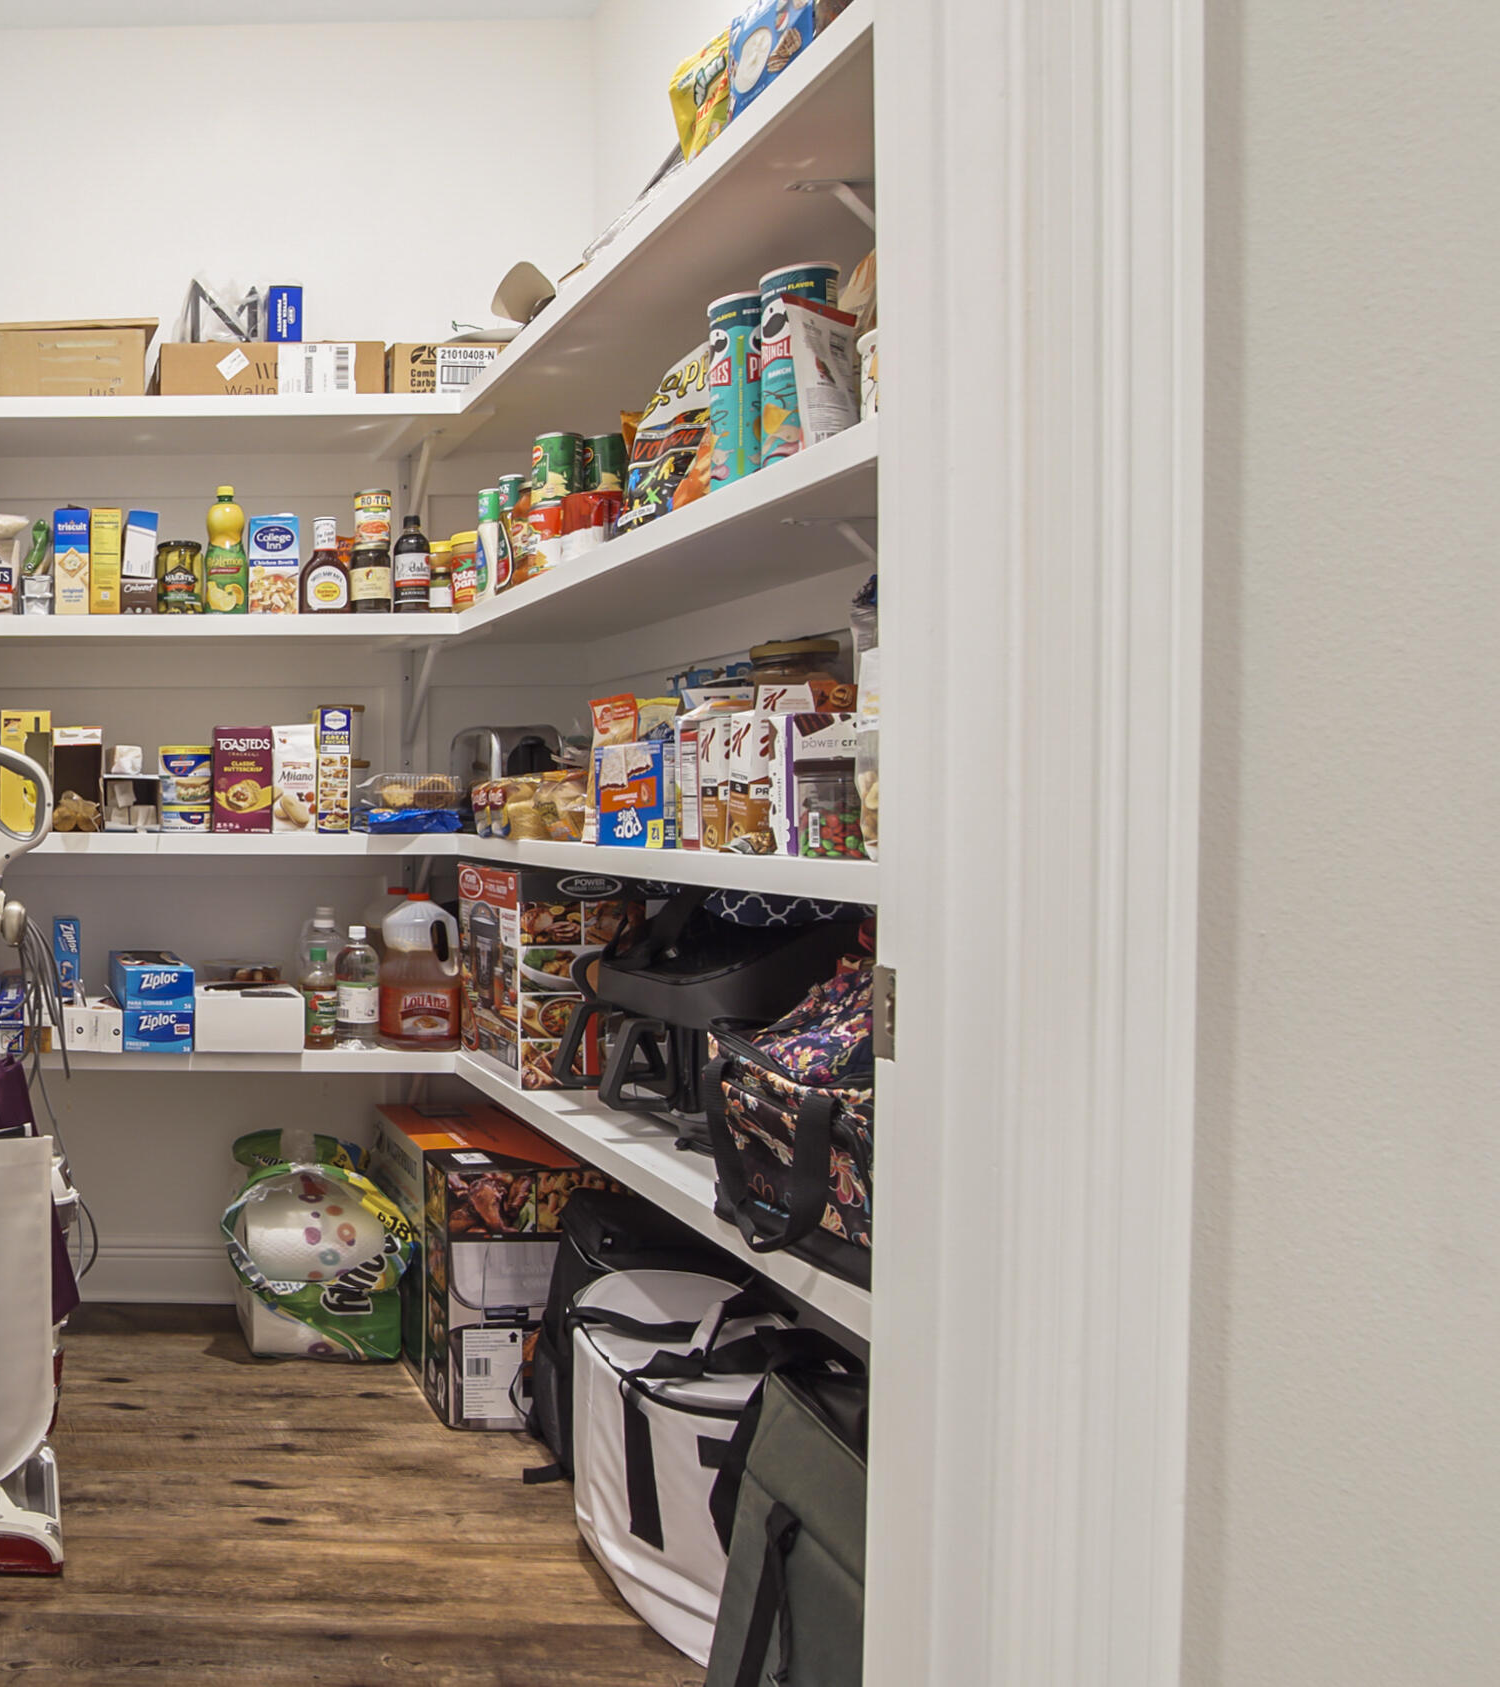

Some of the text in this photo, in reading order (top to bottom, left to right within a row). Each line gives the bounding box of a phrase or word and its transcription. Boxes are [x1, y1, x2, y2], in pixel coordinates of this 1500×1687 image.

[788, 281, 815, 291] FLAVOR
[441, 349, 495, 361] 21010408-N
[57, 522, 87, 531] triscuit
[256, 533, 292, 544] College
[266, 541, 282, 550] Inn
[217, 738, 271, 752] TOASTEDS
[278, 771, 314, 783] Milano
[574, 878, 606, 887] POWER
[60, 923, 78, 953] Ziploc
[141, 972, 179, 990] Ziploc
[404, 996, 447, 1010] LouAna
[139, 1013, 177, 1031] Ziploc
